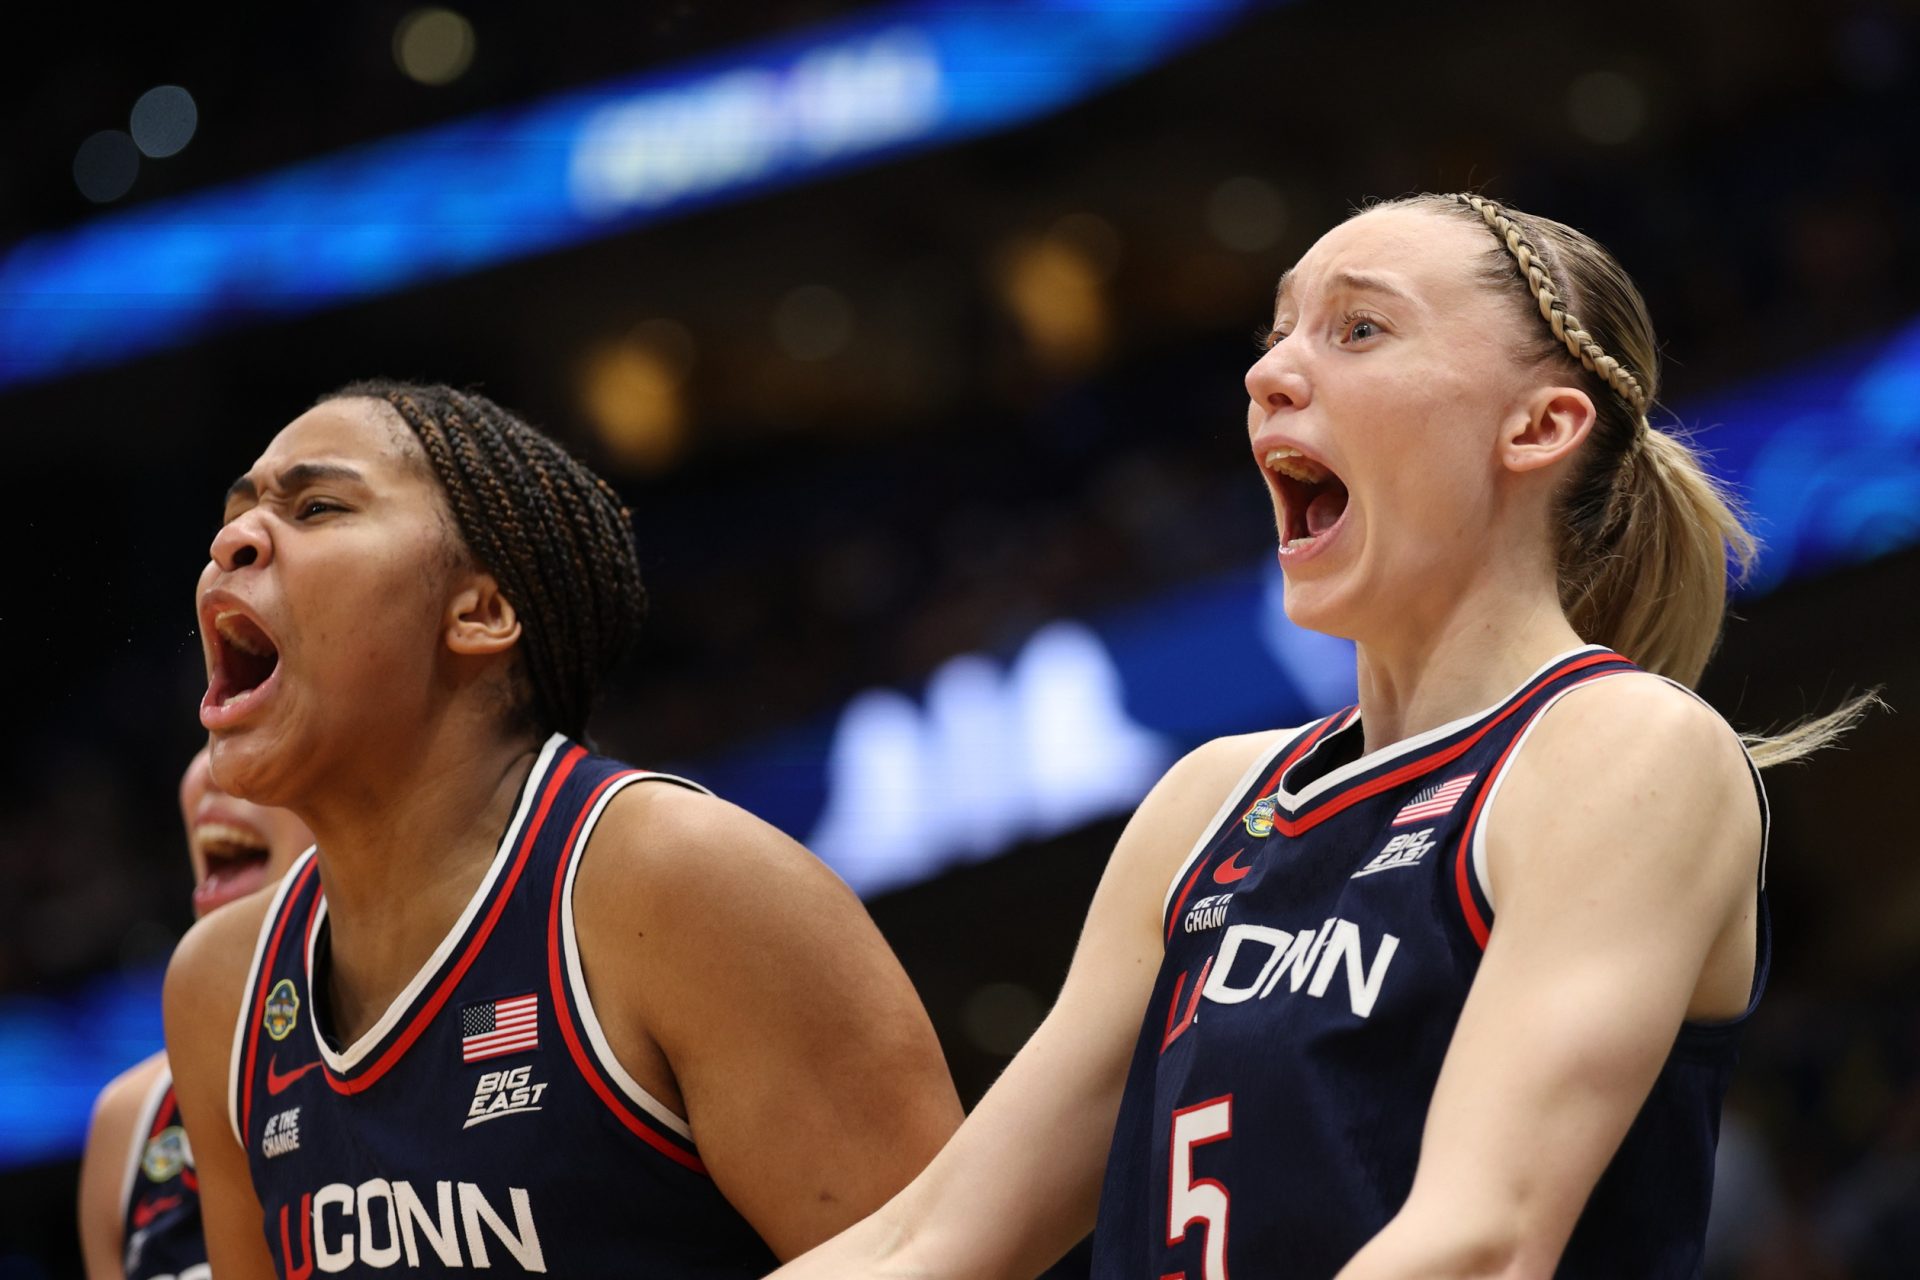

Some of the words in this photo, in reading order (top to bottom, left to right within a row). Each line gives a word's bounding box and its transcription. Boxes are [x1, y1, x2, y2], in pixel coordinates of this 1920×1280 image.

[1363, 840, 1437, 870] EAST
[1380, 827, 1435, 855] BIG
[1184, 905, 1229, 934] CHAN
[1160, 917, 1400, 1056] UONN
[475, 1065, 533, 1096] BIG
[467, 1083, 548, 1117] EAST
[264, 1114, 280, 1138] BE
[278, 1107, 301, 1132] THE
[262, 1127, 300, 1159] CHANGE
[1166, 1093, 1233, 1280] 5
[280, 1177, 548, 1280] UCONN
